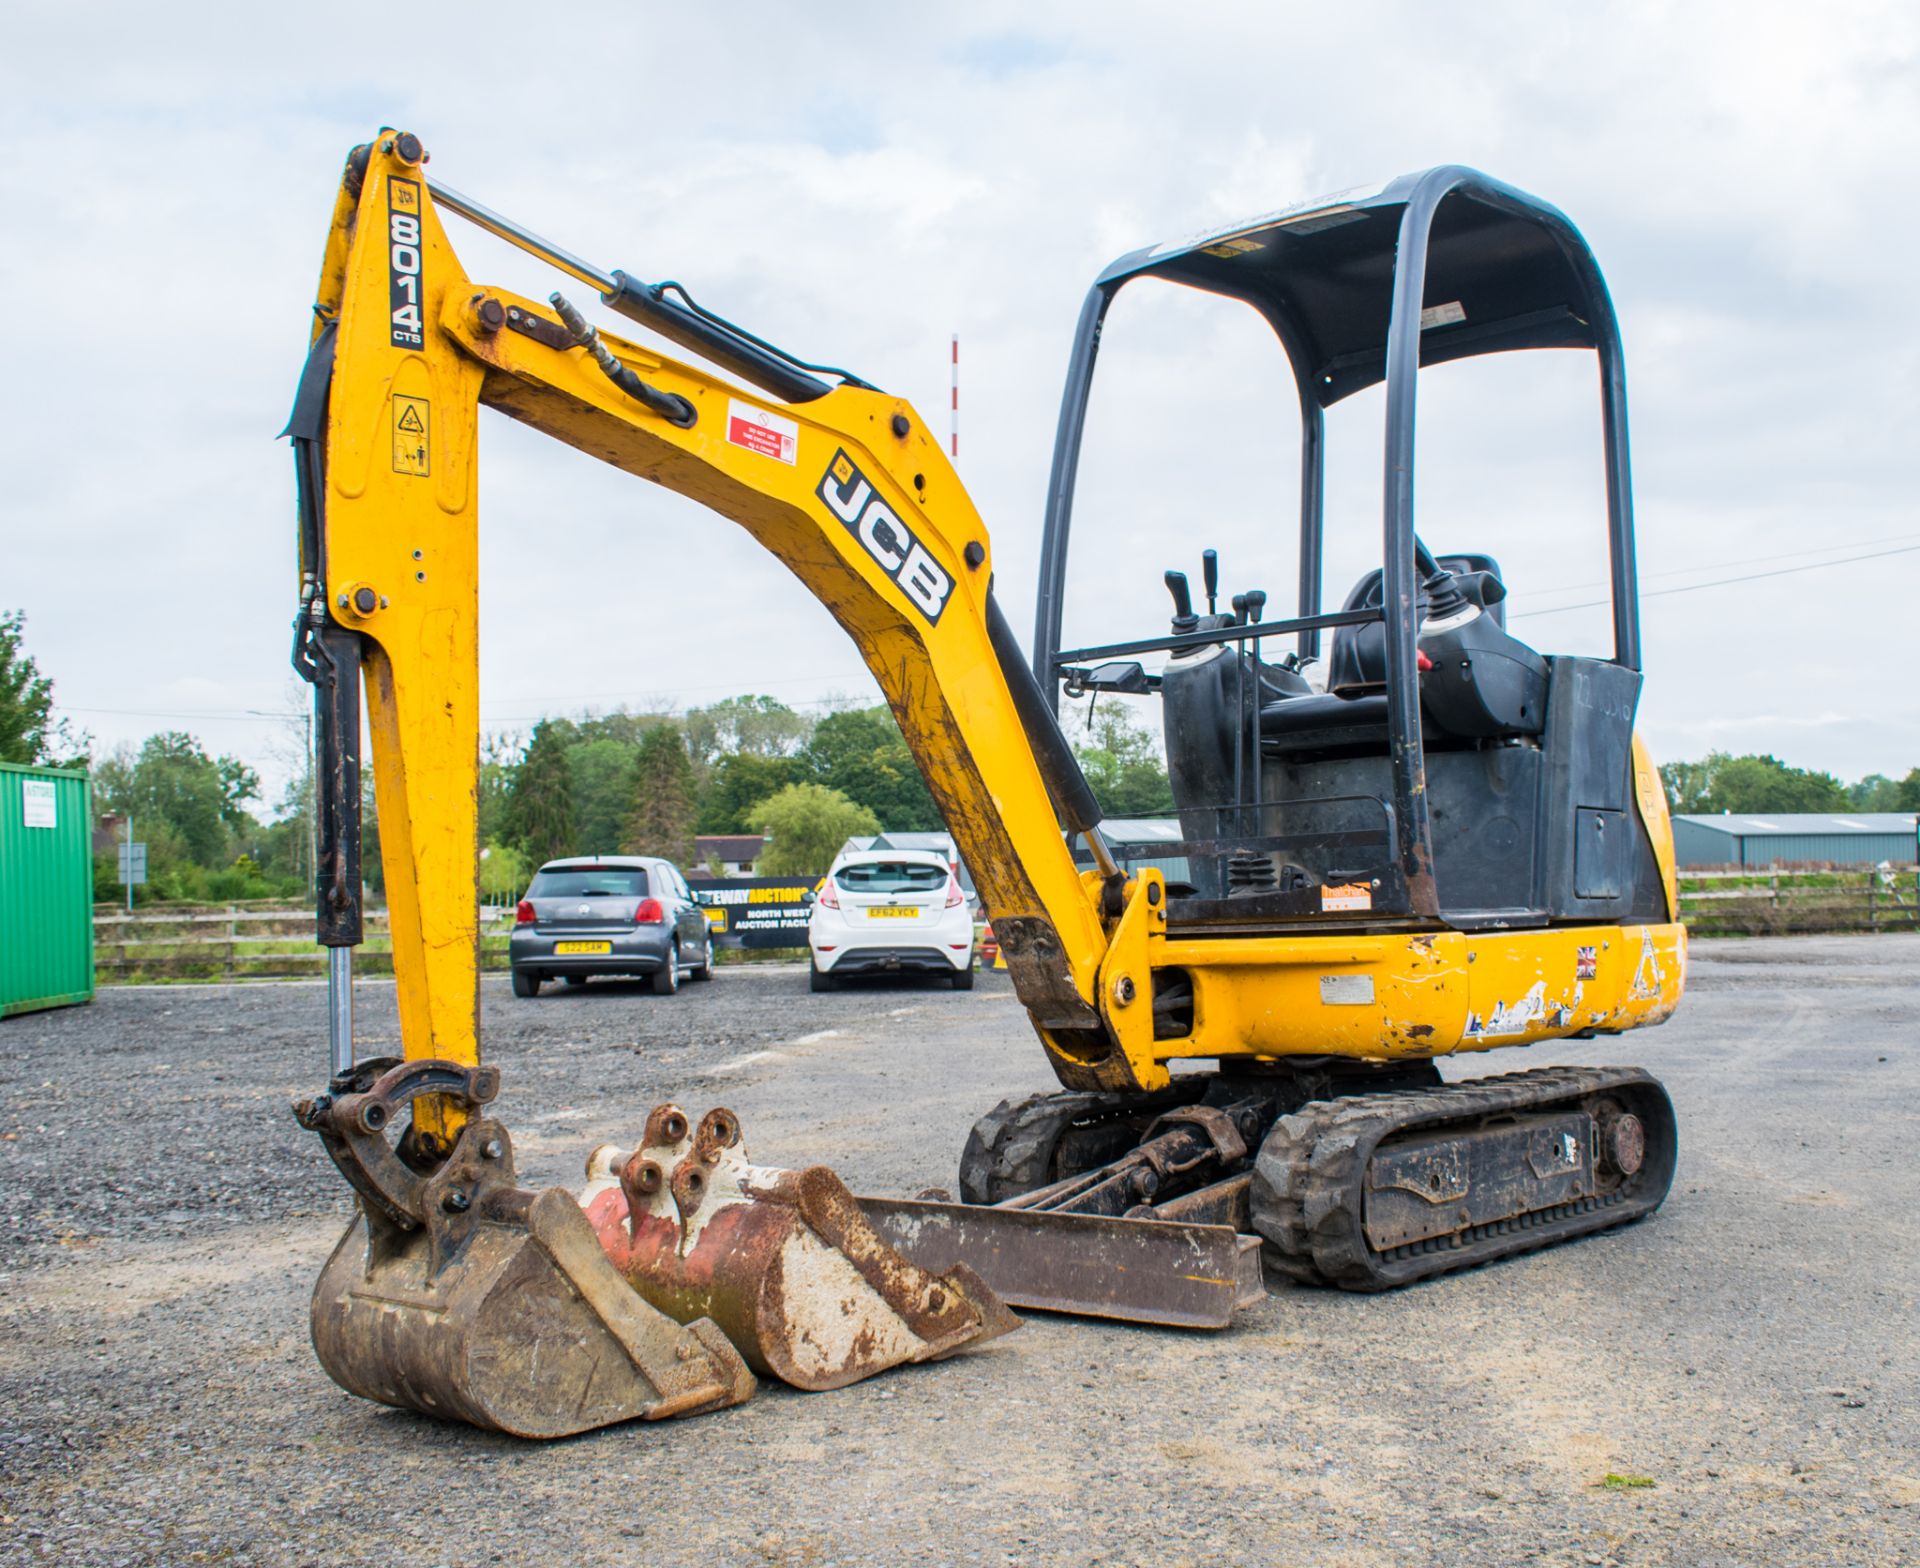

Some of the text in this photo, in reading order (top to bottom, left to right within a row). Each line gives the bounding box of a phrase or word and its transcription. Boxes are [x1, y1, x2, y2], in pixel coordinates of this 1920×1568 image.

[391, 214, 421, 333] 8014
[393, 330, 422, 344] CTS
[823, 475, 950, 617] JCB
[747, 908, 811, 919] NORTH WEST
[735, 919, 809, 930] AUCTION FACIL
